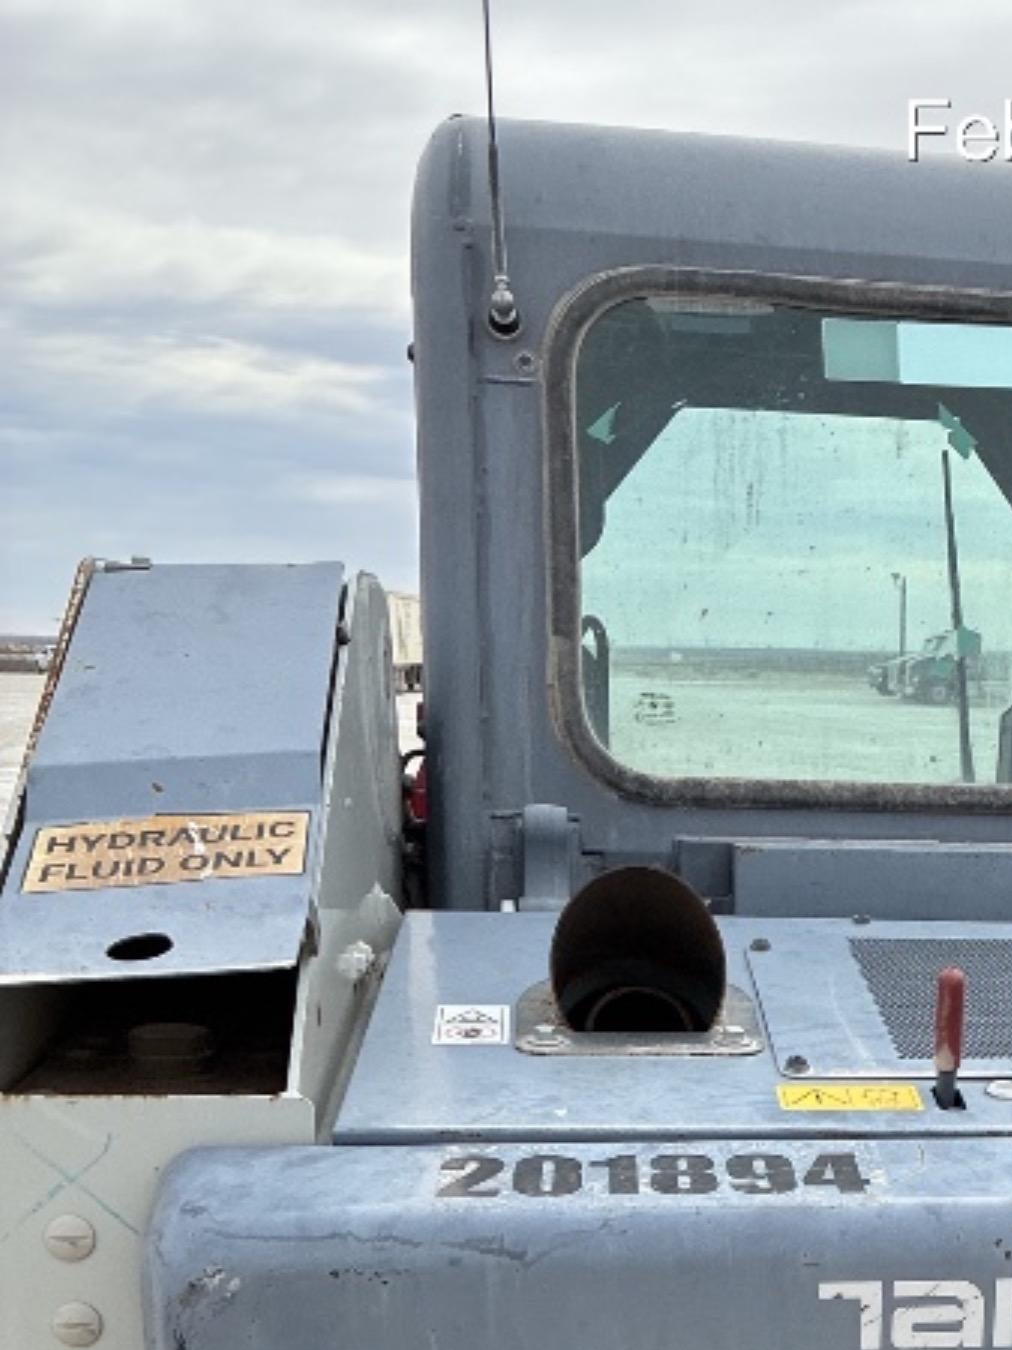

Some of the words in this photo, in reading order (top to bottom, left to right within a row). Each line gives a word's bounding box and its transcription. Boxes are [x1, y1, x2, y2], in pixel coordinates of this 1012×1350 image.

[46, 821, 296, 855] HYDRAULIC
[38, 856, 166, 883] FLUID
[179, 848, 291, 873] ONLY
[434, 1153, 872, 1198] 201894
